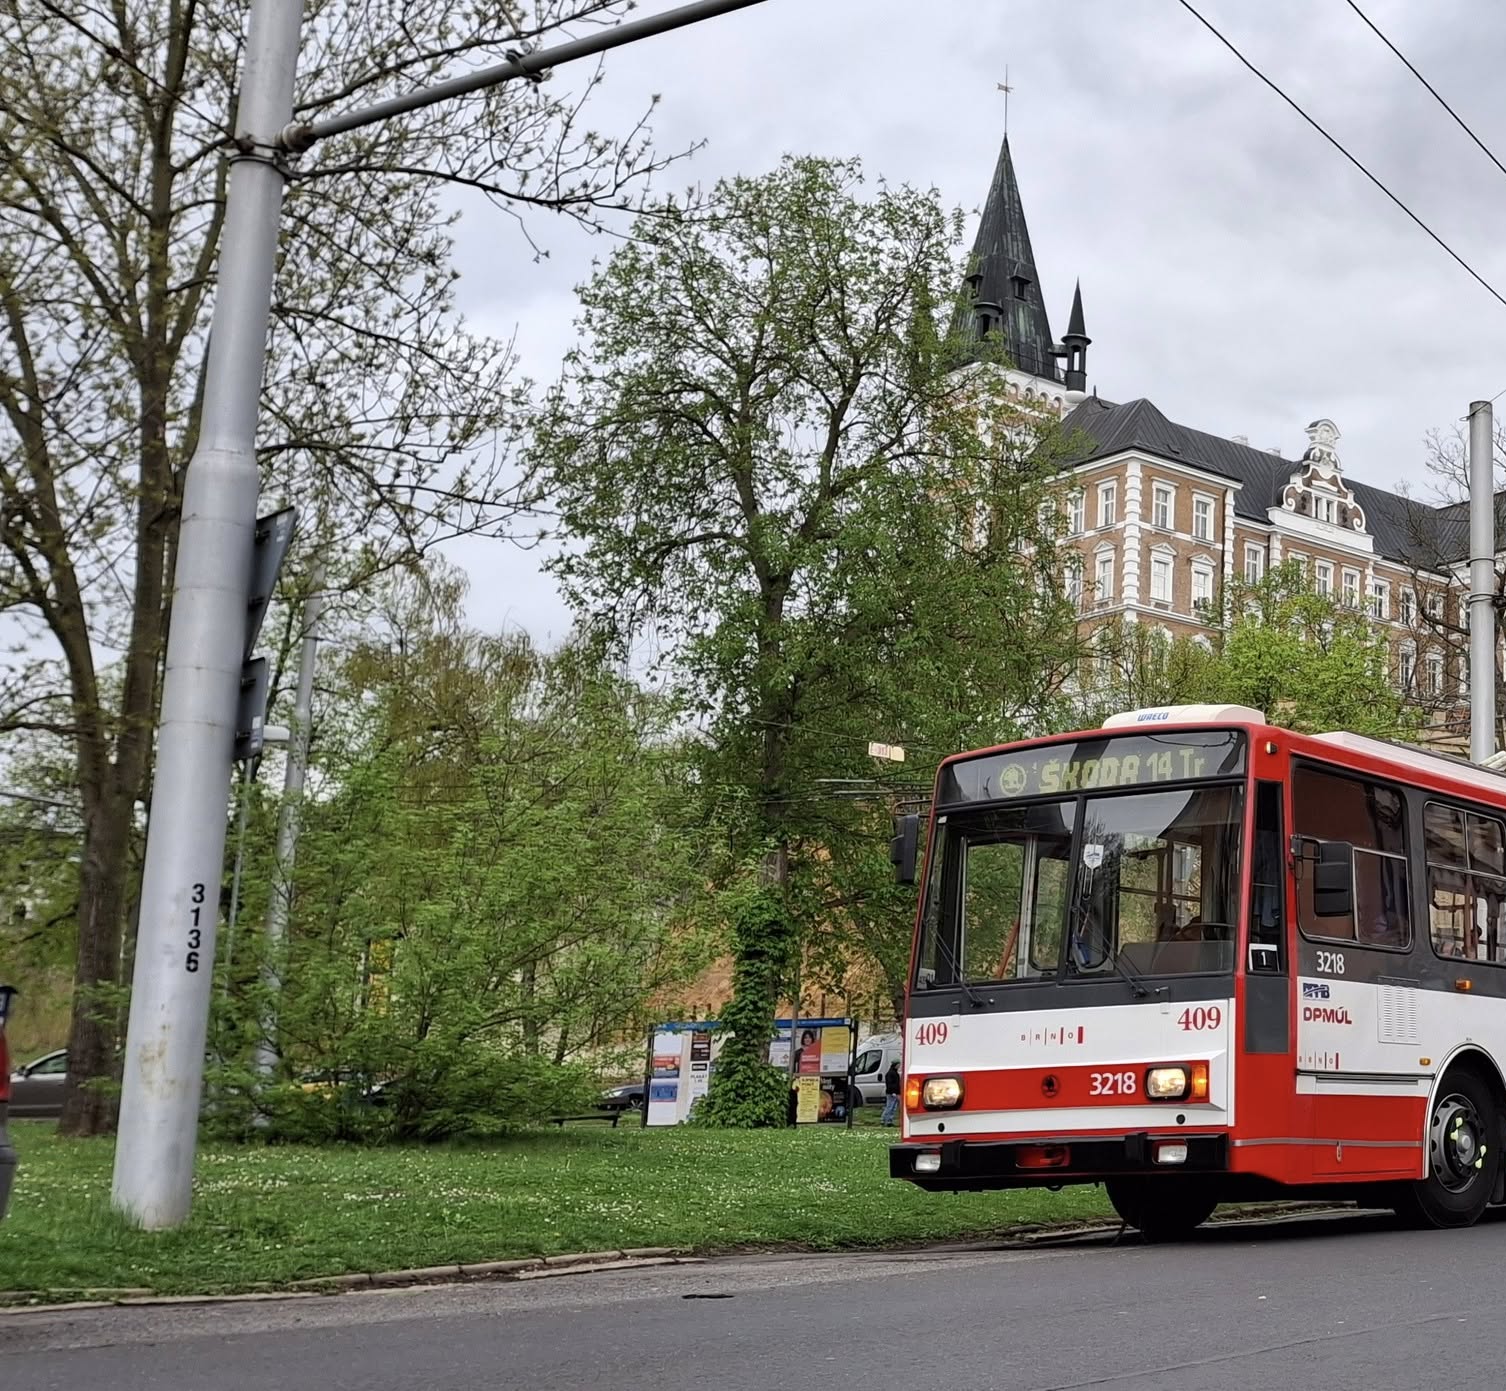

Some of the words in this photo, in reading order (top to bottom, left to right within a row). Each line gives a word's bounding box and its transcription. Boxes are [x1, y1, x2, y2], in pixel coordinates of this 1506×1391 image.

[1038, 755, 1140, 794] ŠKODA
[1146, 751, 1173, 779] 14
[1179, 748, 1205, 779] Tr
[185, 882, 206, 974] 3136
[1260, 951, 1267, 967] 1
[1315, 950, 1345, 975] 3218
[1177, 1006, 1222, 1032] 409
[1303, 1006, 1353, 1025] DPMÚL
[915, 1021, 948, 1046] 409
[1089, 1071, 1137, 1096] 3218
